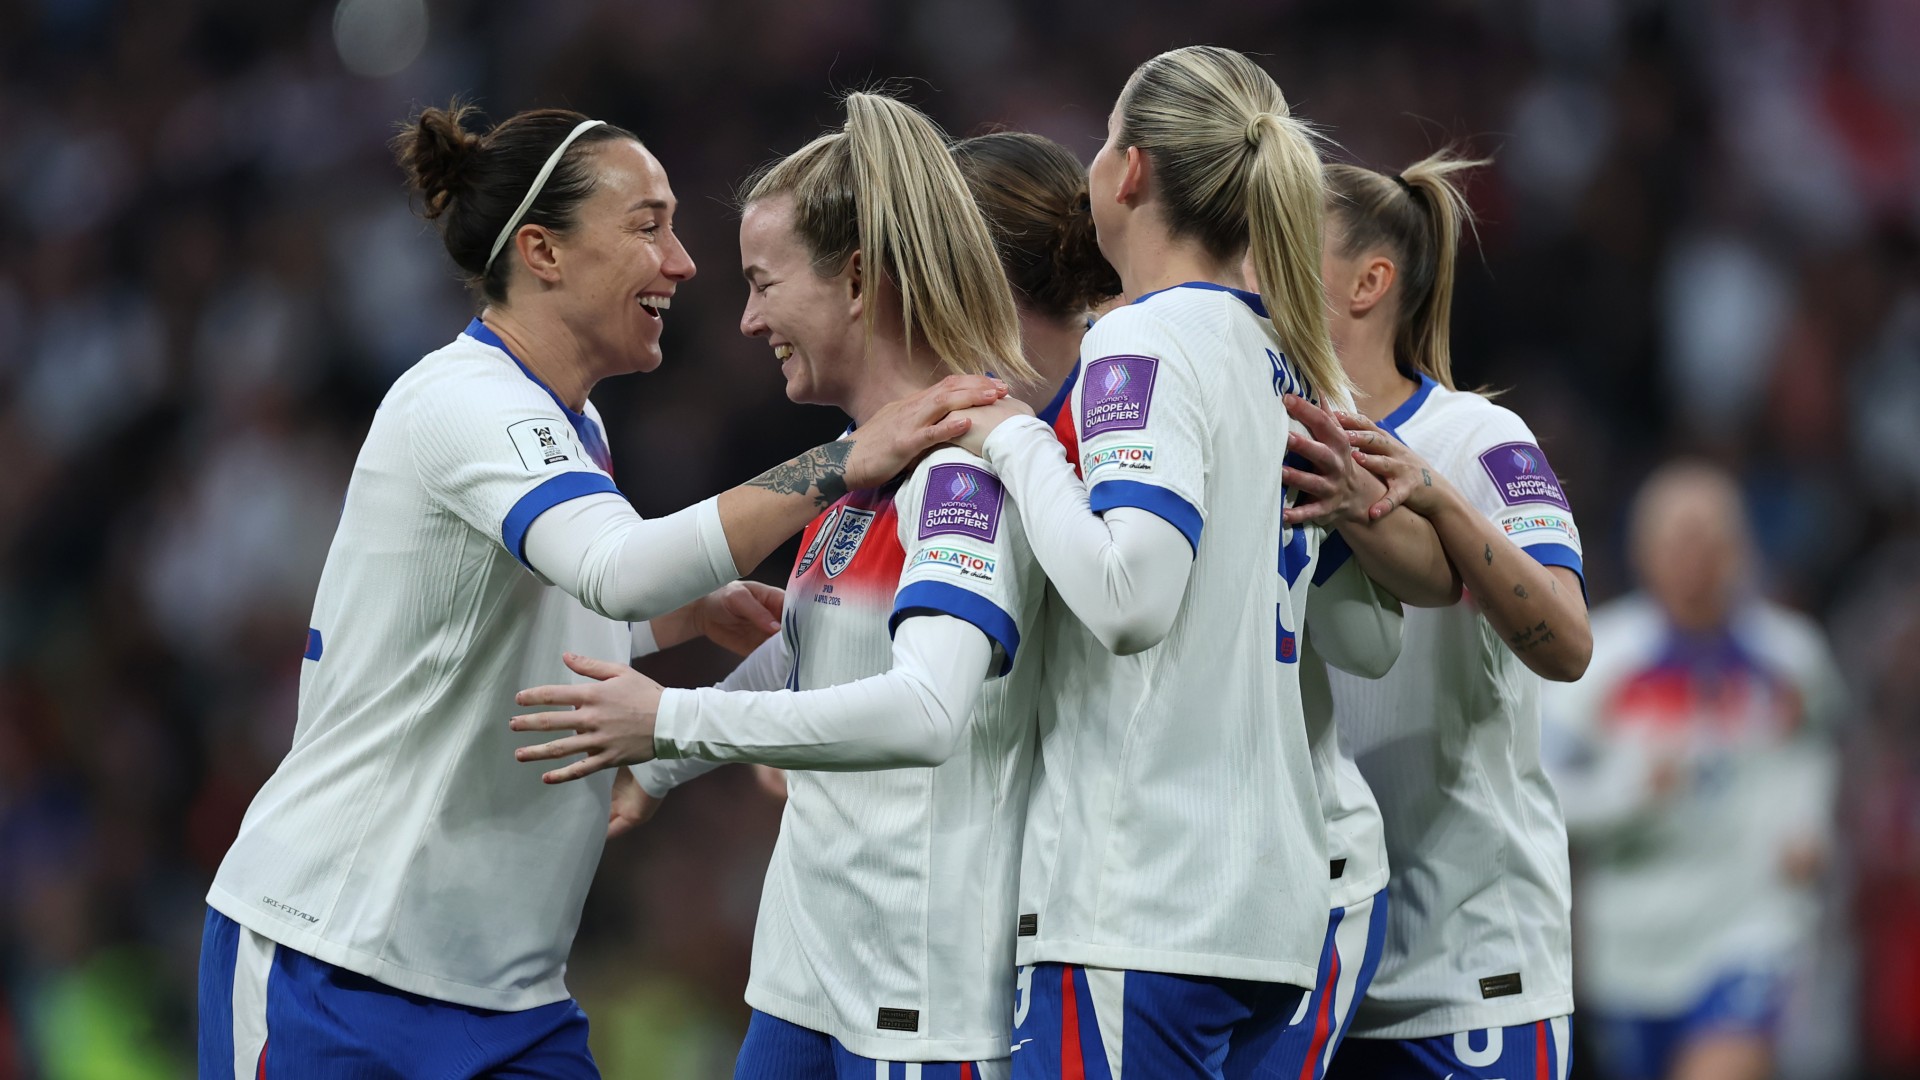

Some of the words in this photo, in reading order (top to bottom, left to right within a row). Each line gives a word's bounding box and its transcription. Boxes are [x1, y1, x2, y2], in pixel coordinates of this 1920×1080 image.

[1096, 394, 1129, 405] women's
[1086, 402, 1140, 418] EUROPEAN
[1085, 410, 1139, 428] QUALIFIERS
[1506, 480, 1558, 494] EUROPEAN
[1508, 487, 1563, 501] QUALIFIERS
[940, 501, 978, 510] women's
[927, 507, 989, 522] EUROPEAN
[1501, 516, 1523, 525] UEFA
[925, 516, 989, 530] QUALIFIERS
